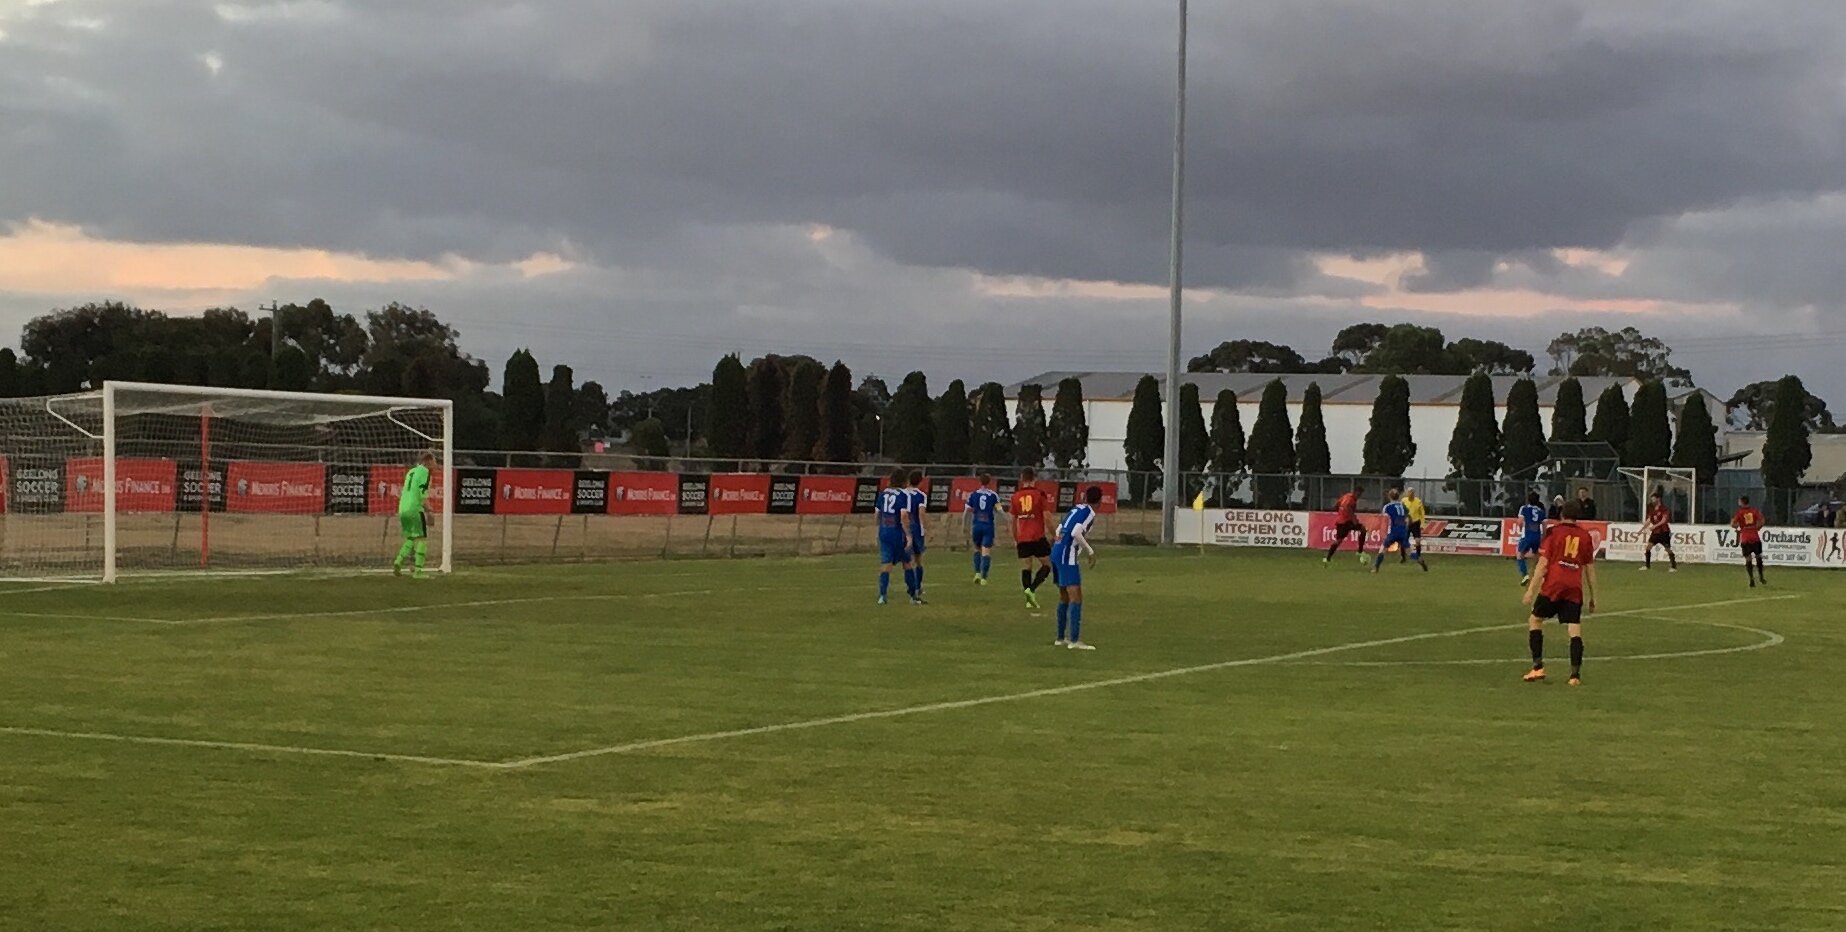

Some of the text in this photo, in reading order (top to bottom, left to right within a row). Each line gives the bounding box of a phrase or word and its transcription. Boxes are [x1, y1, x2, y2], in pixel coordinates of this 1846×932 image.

[16, 481, 58, 494] SOCCER
[183, 482, 222, 494] SOCER
[406, 471, 415, 492] 1
[331, 485, 364, 496] SOCCER
[461, 488, 491, 498] SOCCER
[883, 493, 896, 514] 12
[979, 494, 987, 511] 6
[1225, 510, 1294, 524] GEELONG
[1531, 508, 1540, 522] 5
[1214, 523, 1306, 537] KITCHEN CO.
[1762, 529, 1811, 544] Orchards
[1254, 536, 1278, 545] 5272
[1563, 534, 1581, 559] 14
